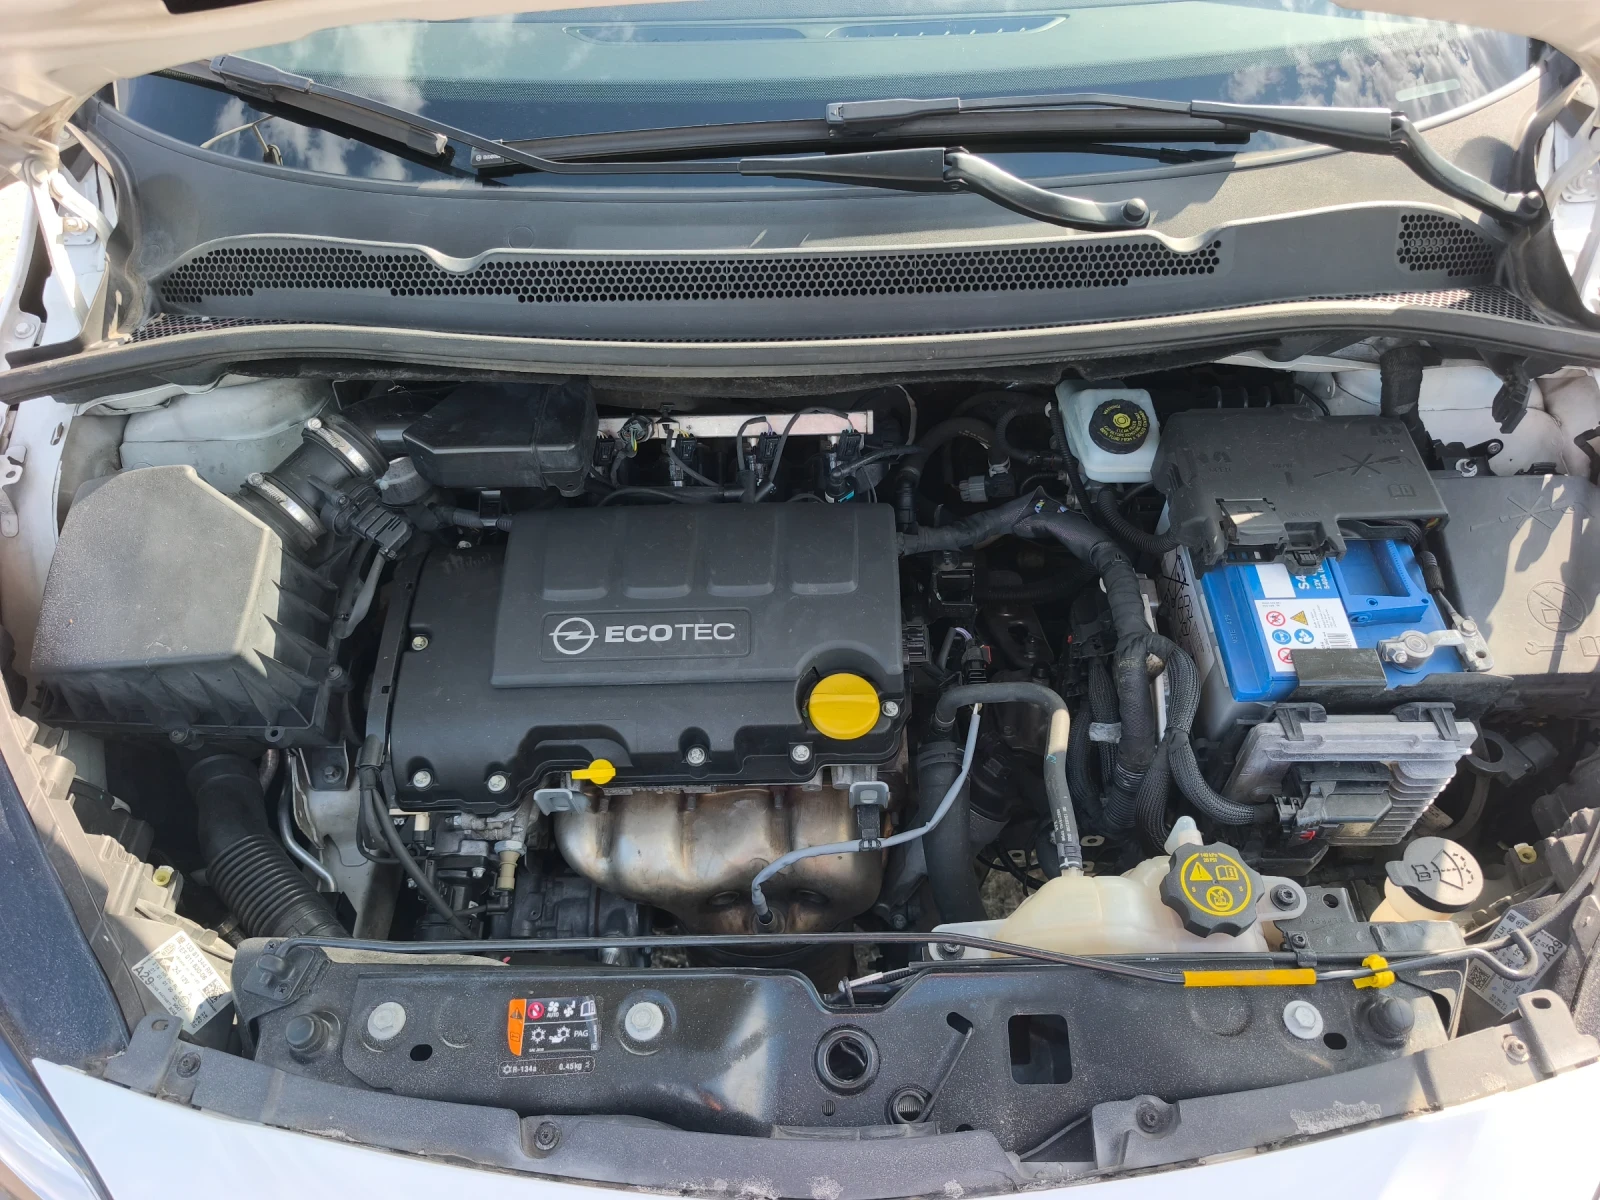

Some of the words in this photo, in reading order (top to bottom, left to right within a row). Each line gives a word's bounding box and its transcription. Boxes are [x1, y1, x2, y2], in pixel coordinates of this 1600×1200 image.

[604, 623, 736, 643] ECOTEC
[1543, 940, 1563, 962] A29
[133, 966, 154, 986] A29
